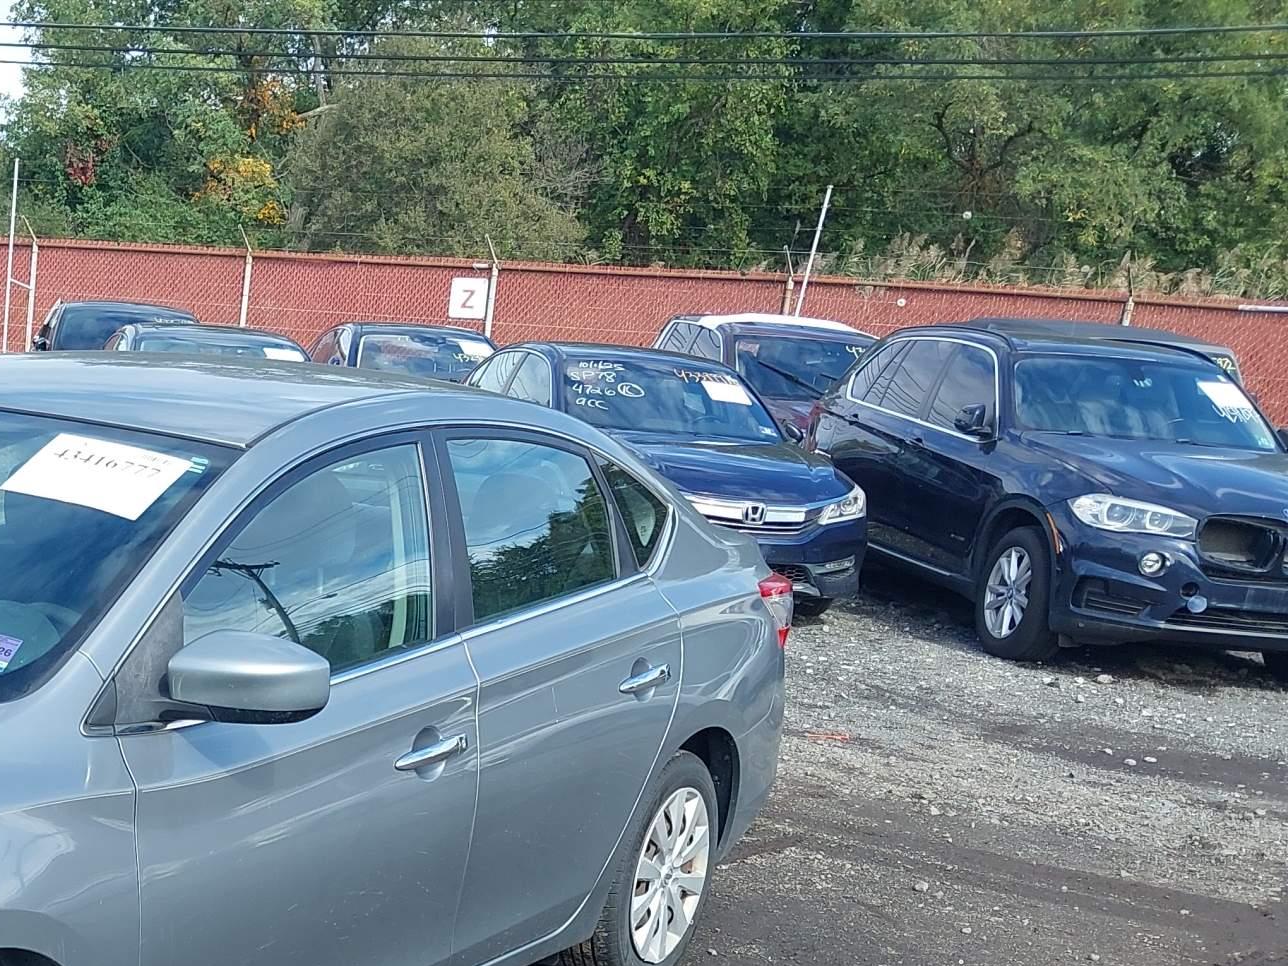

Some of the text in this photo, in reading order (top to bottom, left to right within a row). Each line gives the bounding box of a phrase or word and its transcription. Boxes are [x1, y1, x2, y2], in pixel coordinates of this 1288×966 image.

[460, 289, 475, 309] Z
[572, 383, 616, 396] 4726
[53, 448, 161, 478] 43416777
